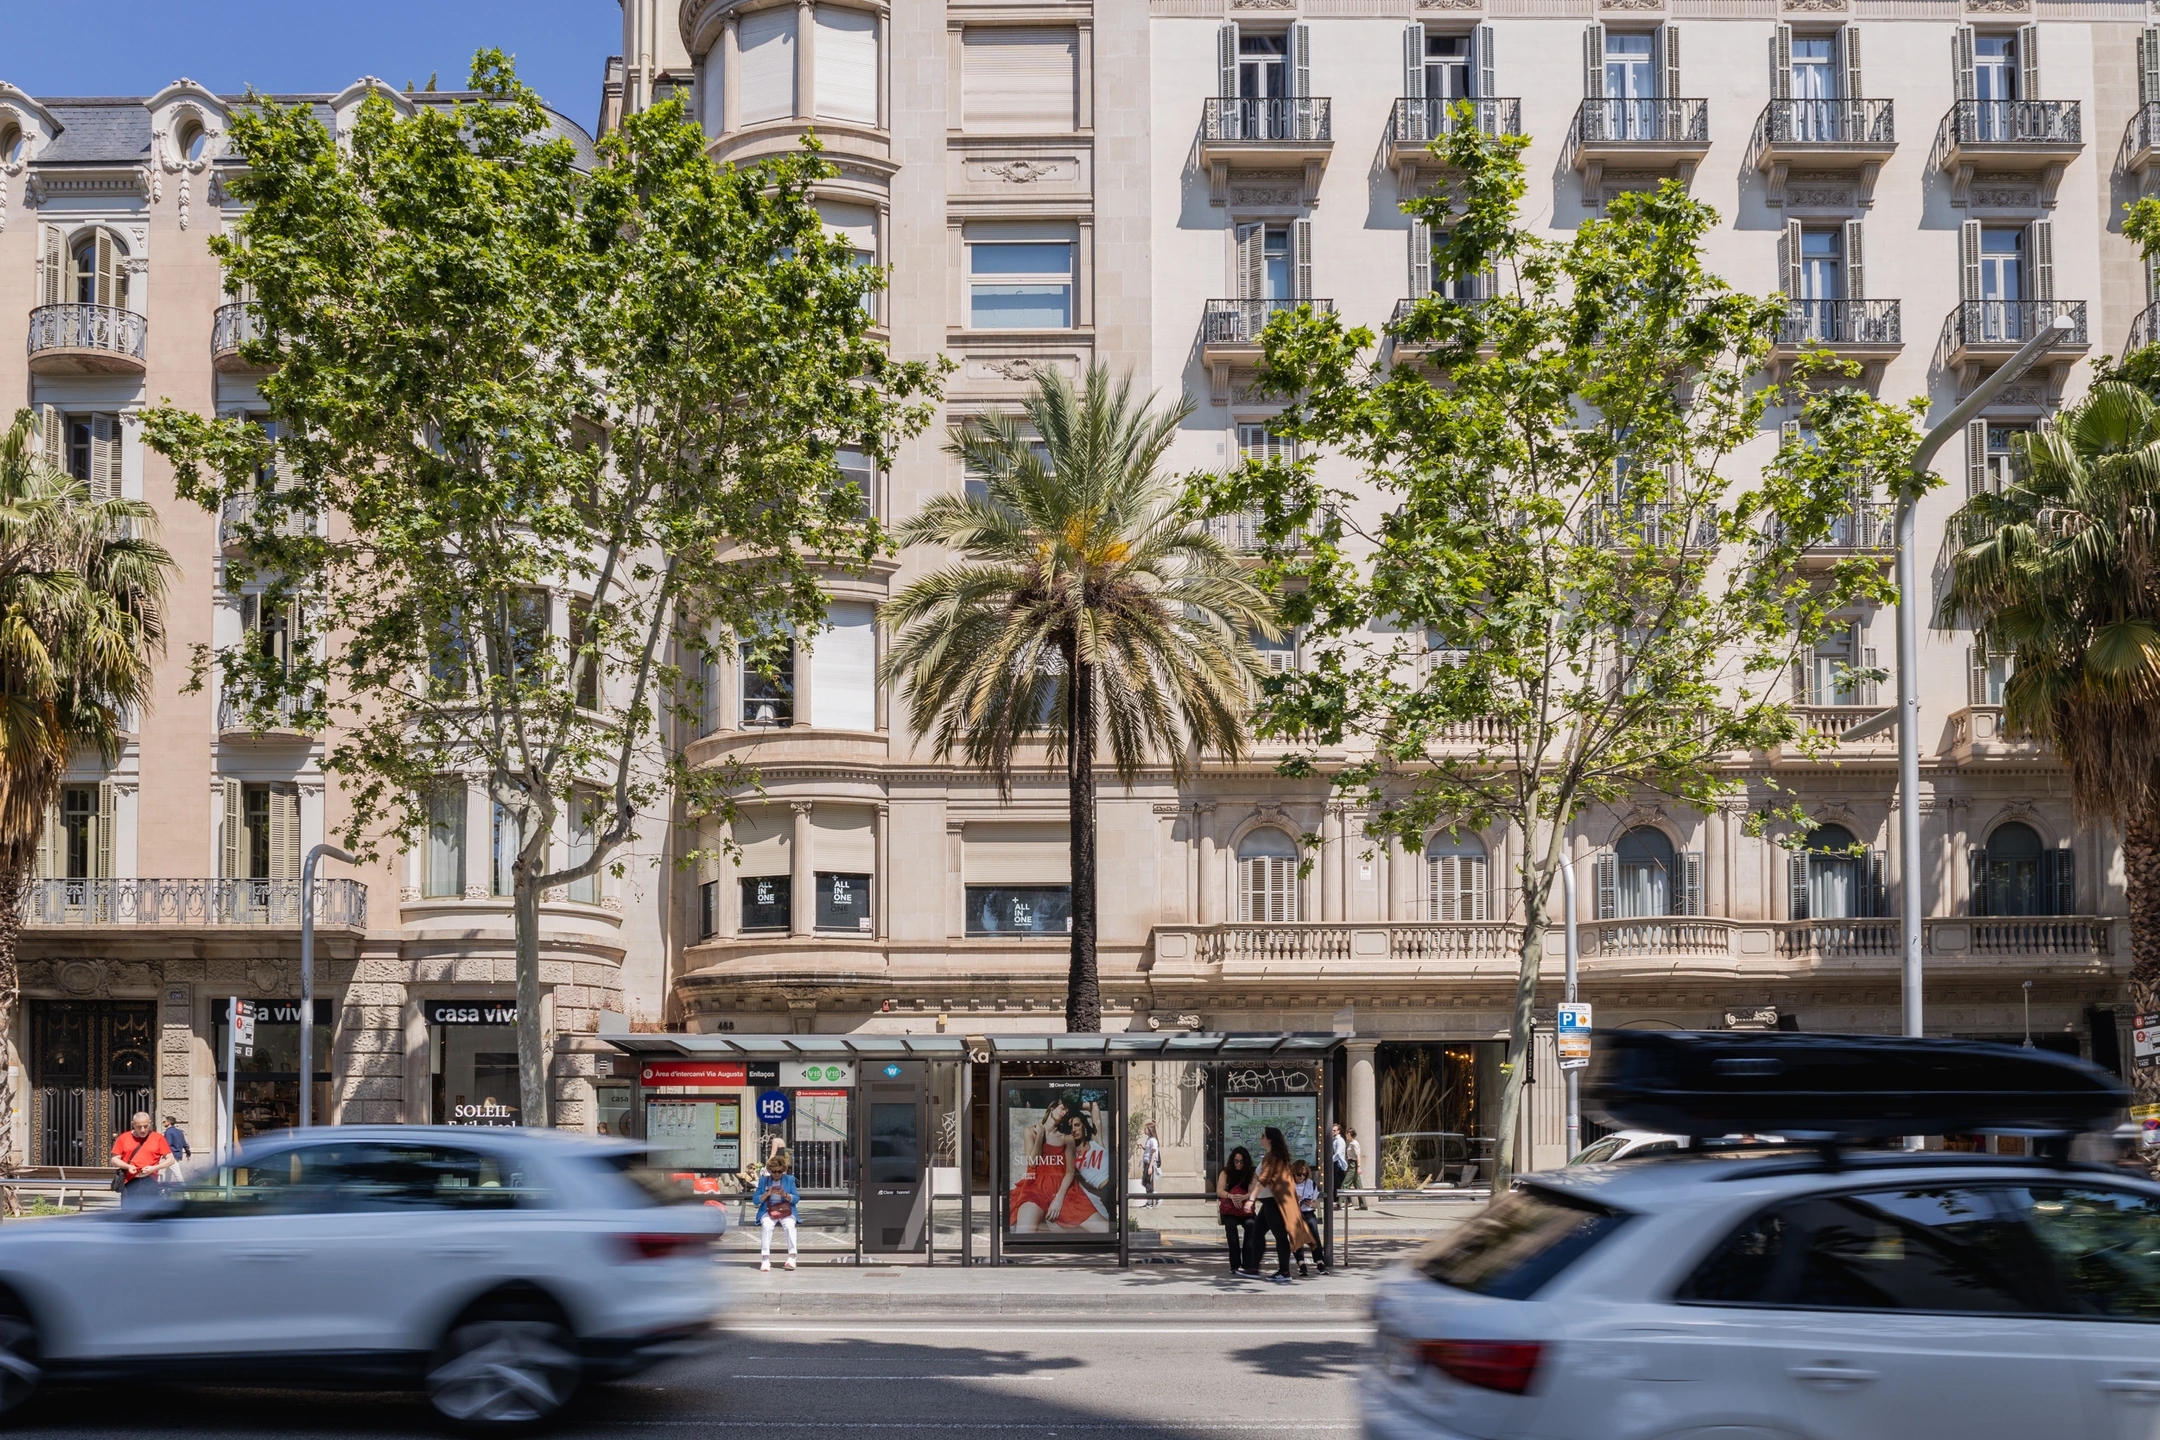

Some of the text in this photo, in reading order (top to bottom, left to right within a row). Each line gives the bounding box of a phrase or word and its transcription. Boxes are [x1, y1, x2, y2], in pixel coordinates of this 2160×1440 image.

[274, 1002, 302, 1021] viv
[435, 1004, 518, 1022] casa viv
[1563, 1013, 1572, 1026] P
[718, 1022, 734, 1031] 488
[718, 1070, 743, 1078] Augusta
[749, 1070, 775, 1078] Enllaços
[455, 1105, 510, 1117] SOLEIL
[762, 1100, 784, 1114] H8
[1014, 1155, 1064, 1166] SUMMER
[1073, 1149, 1104, 1170] H&M
